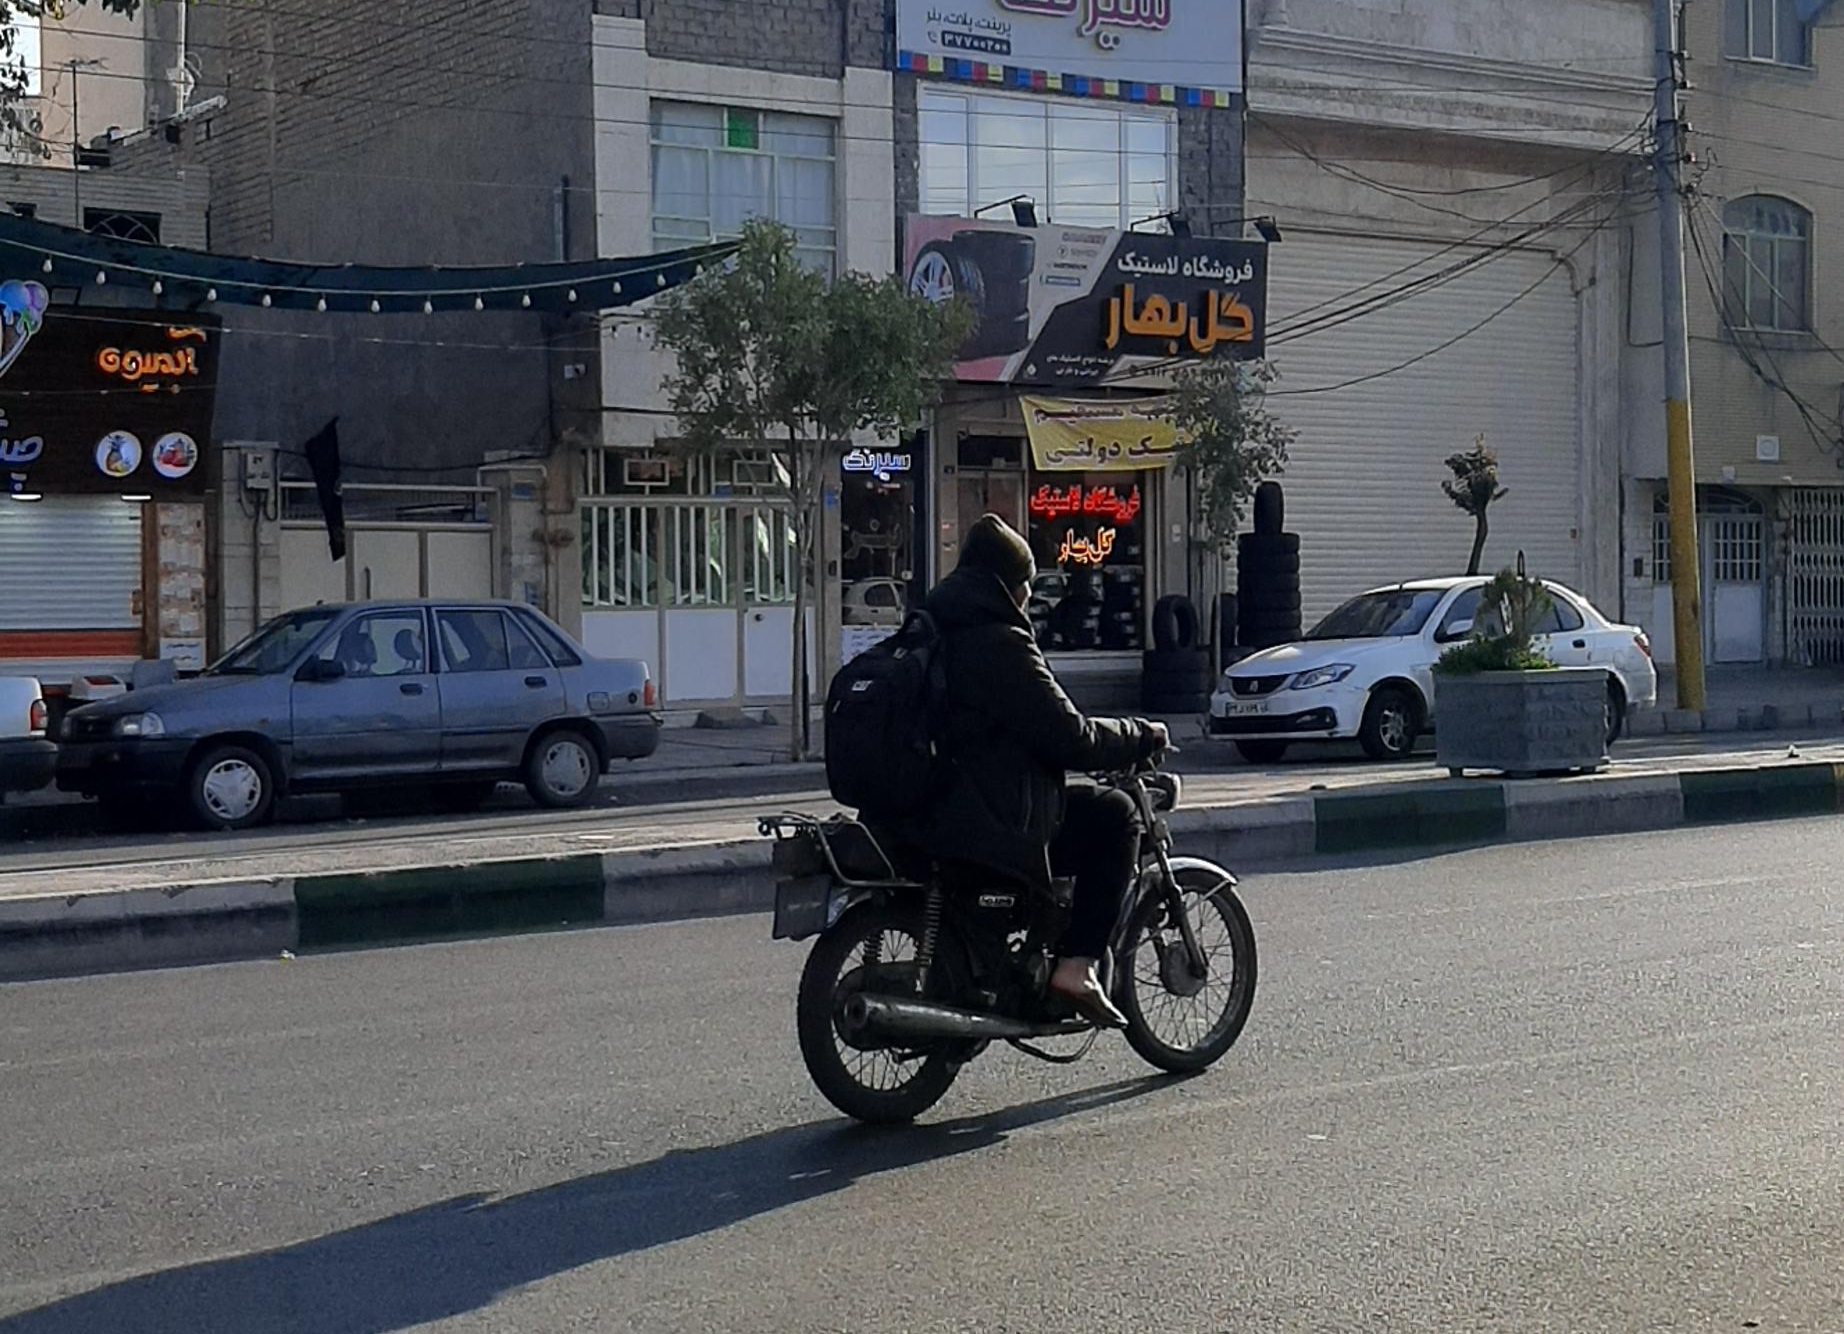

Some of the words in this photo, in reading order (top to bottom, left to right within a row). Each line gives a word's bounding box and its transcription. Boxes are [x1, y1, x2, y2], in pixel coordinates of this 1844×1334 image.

[1117, 251, 1179, 278] لاستیک
[1182, 256, 1254, 285] فروشگاه
[1104, 283, 1188, 355] بهار
[1189, 289, 1254, 353] گل
[842, 447, 912, 482] سیرنگ
[1046, 436, 1121, 464] دولتی
[1030, 483, 1082, 516] لاستیک
[1088, 526, 1116, 563] گل
